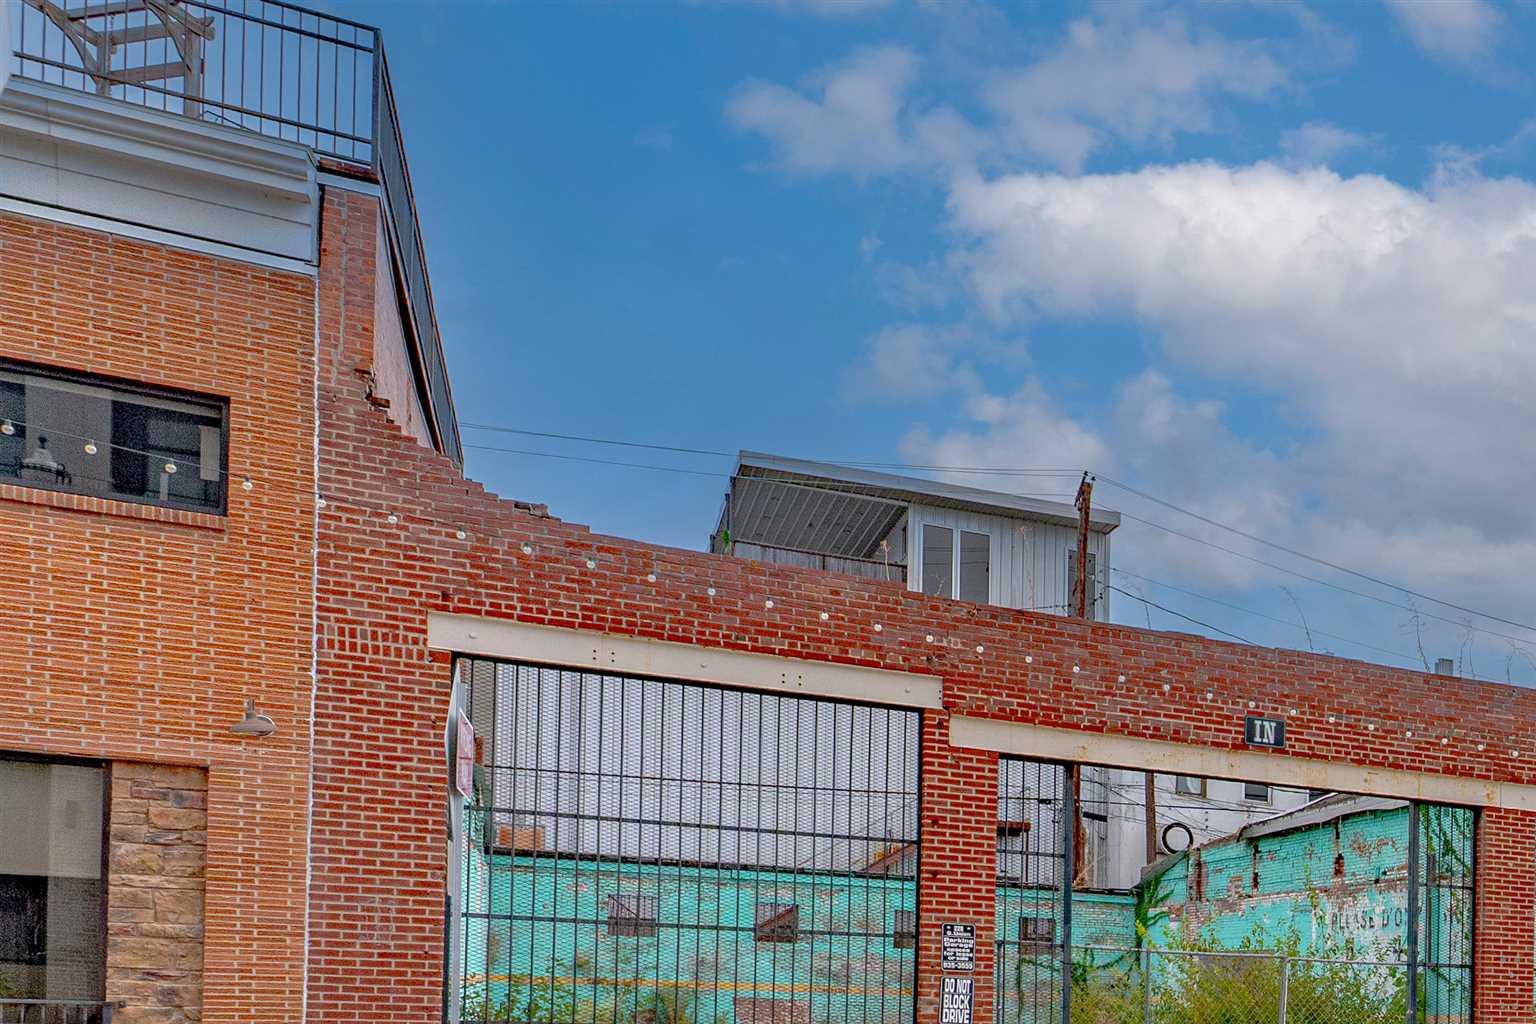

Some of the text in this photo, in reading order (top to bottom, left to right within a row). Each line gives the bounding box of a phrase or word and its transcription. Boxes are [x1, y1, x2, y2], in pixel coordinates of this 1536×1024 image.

[1253, 719, 1276, 744] IN
[944, 941, 973, 949] Garage
[944, 978, 972, 994] DO NOT
[943, 993, 970, 1009] BLOCK
[942, 1008, 970, 1024] DRIVE
